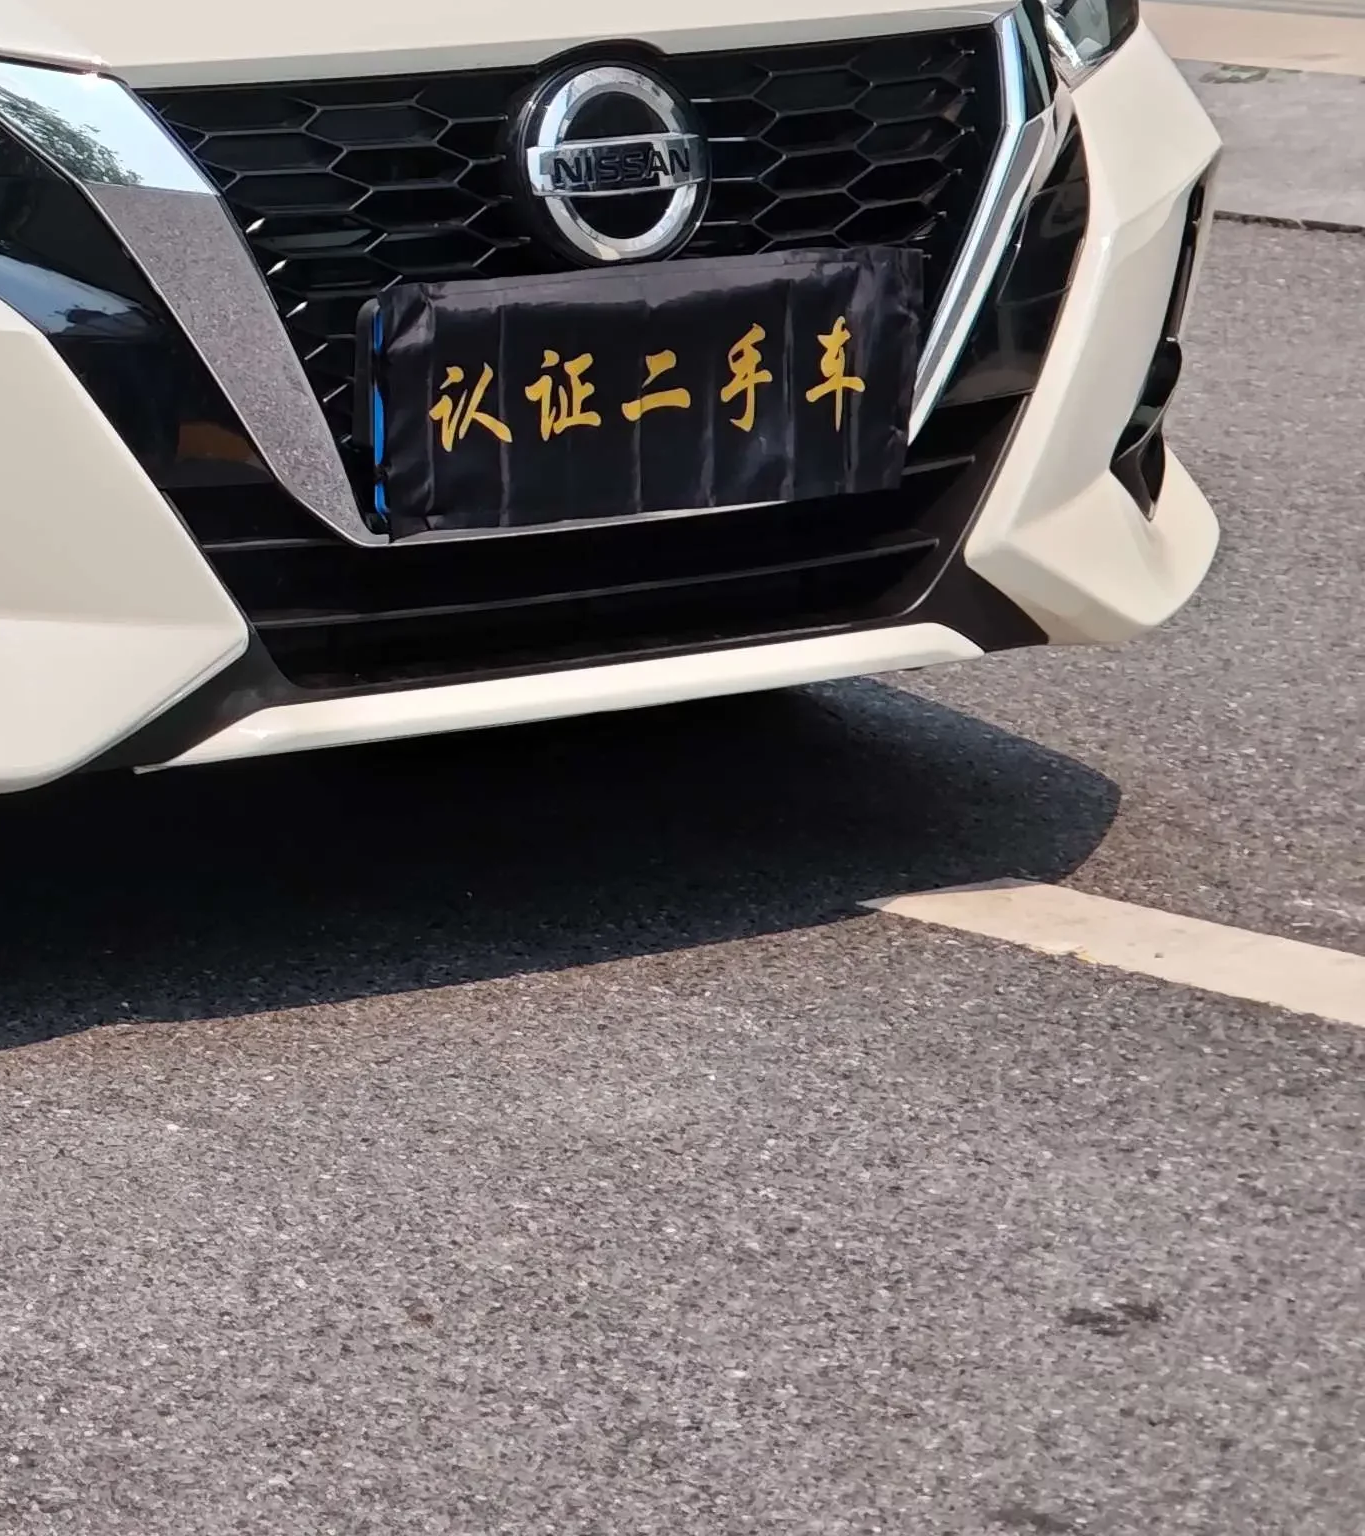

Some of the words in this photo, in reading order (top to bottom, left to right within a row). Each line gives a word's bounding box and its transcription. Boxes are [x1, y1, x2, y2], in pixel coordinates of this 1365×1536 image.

[551, 147, 691, 190] NISSAN
[429, 315, 866, 452] 认证二手车
